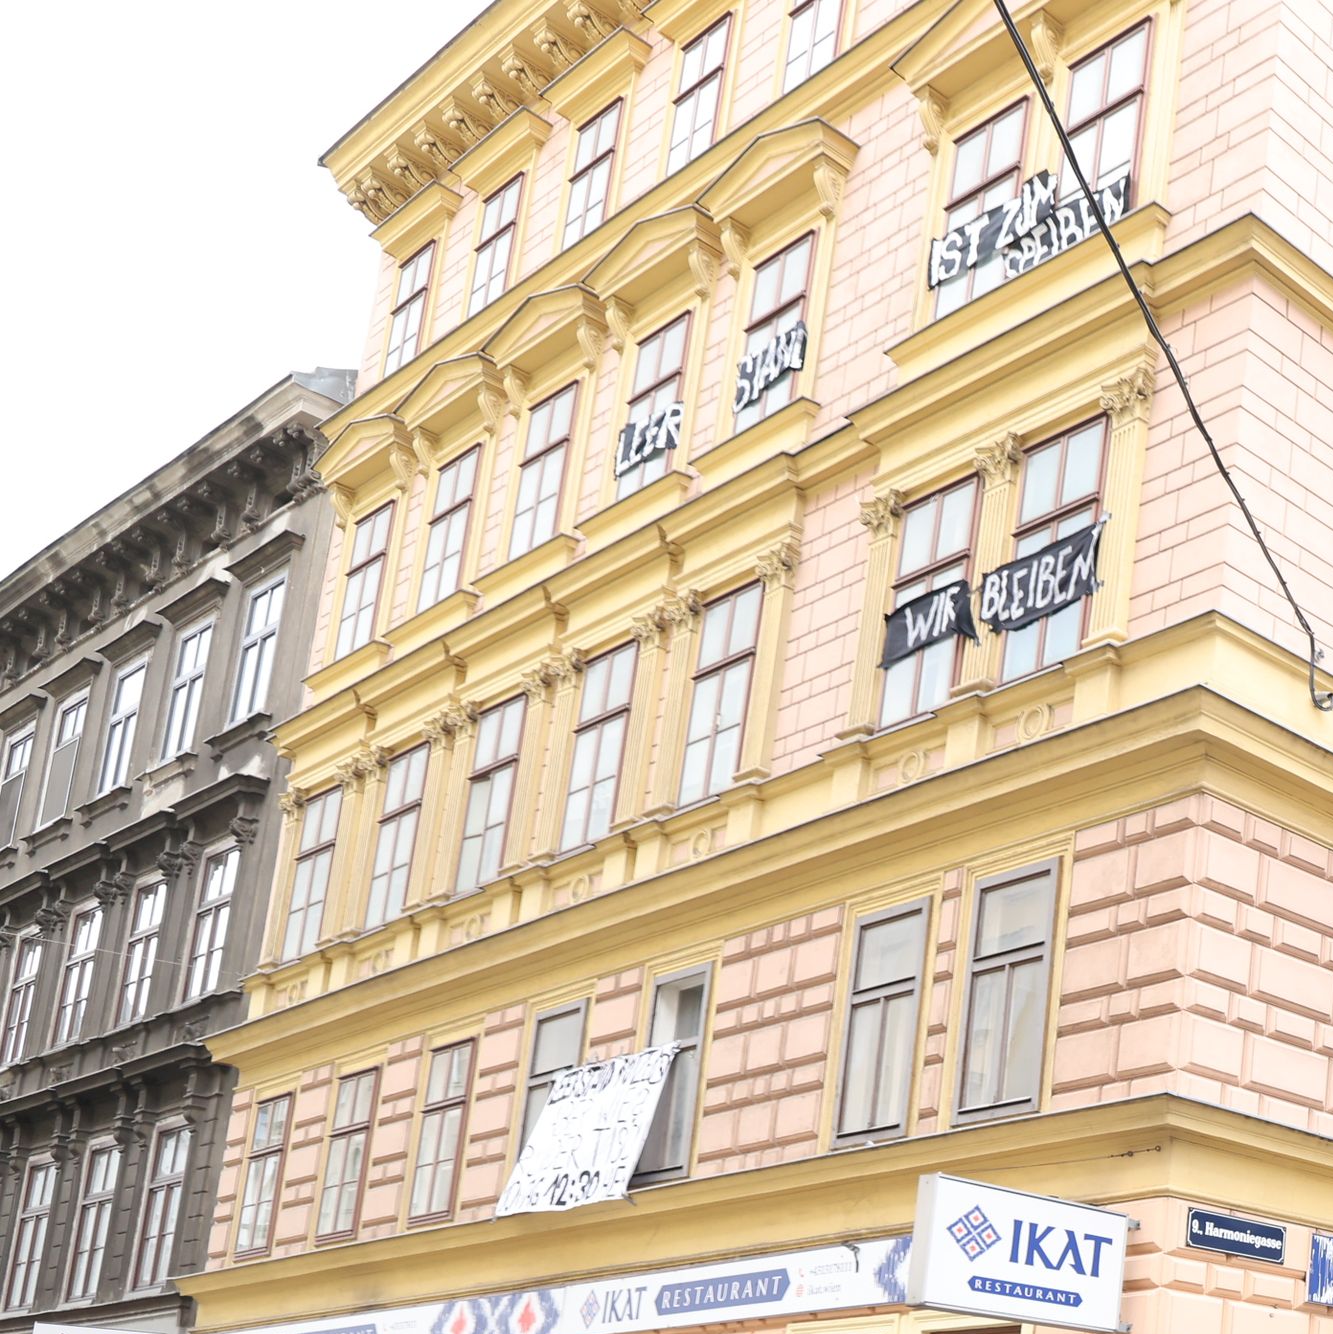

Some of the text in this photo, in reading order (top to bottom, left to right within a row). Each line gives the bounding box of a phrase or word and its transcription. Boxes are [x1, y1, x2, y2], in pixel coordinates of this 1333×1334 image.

[931, 173, 1058, 287] IST ZUM
[616, 403, 684, 477] LEER
[905, 529, 1100, 648] WIR BLEIBEN
[545, 1169, 601, 1206] 12:30
[1009, 1219, 1113, 1278] IKAT
[1205, 1221, 1282, 1249] Harmoniegasse
[601, 1275, 783, 1323] IKAT RESTAURANT
[974, 1279, 1077, 1305] RESTAURANT
